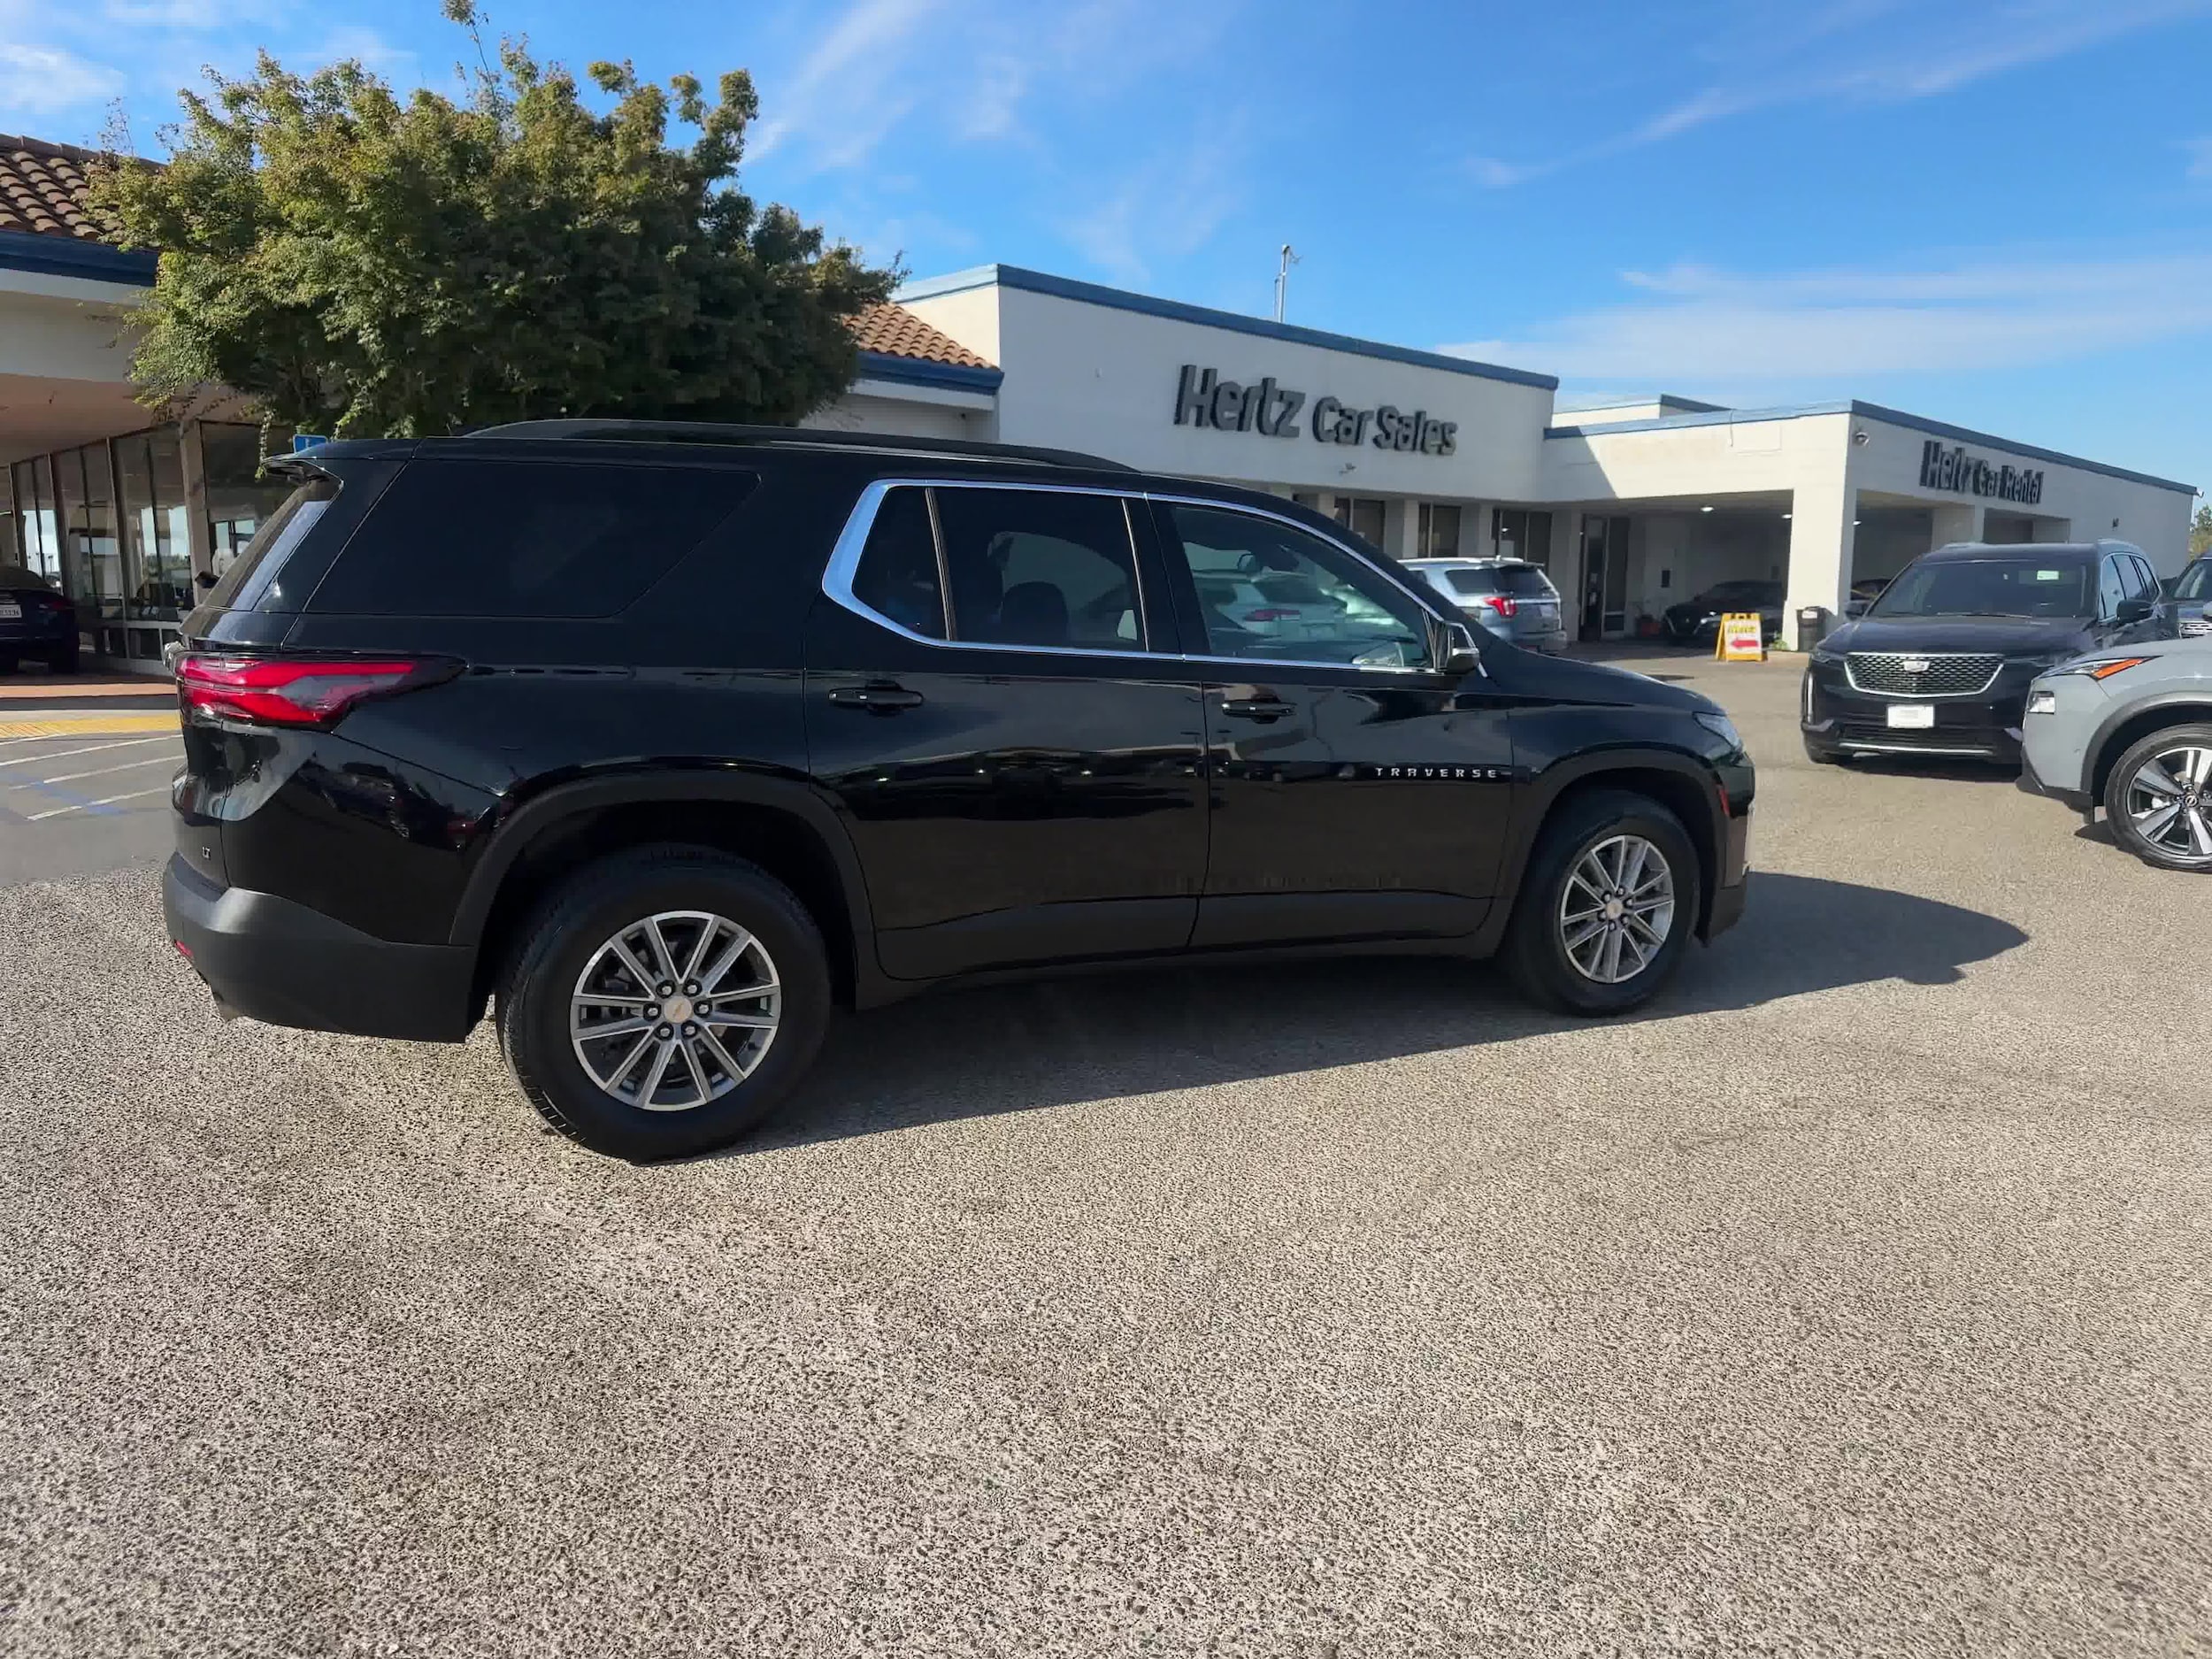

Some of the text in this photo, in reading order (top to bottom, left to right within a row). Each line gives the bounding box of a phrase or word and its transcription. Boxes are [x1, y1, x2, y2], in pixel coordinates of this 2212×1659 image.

[1173, 365, 1458, 456] Hertz Car Sales
[1919, 441, 2045, 504] Hertz Car Rental
[1375, 767, 1497, 778] TRAVERSE
